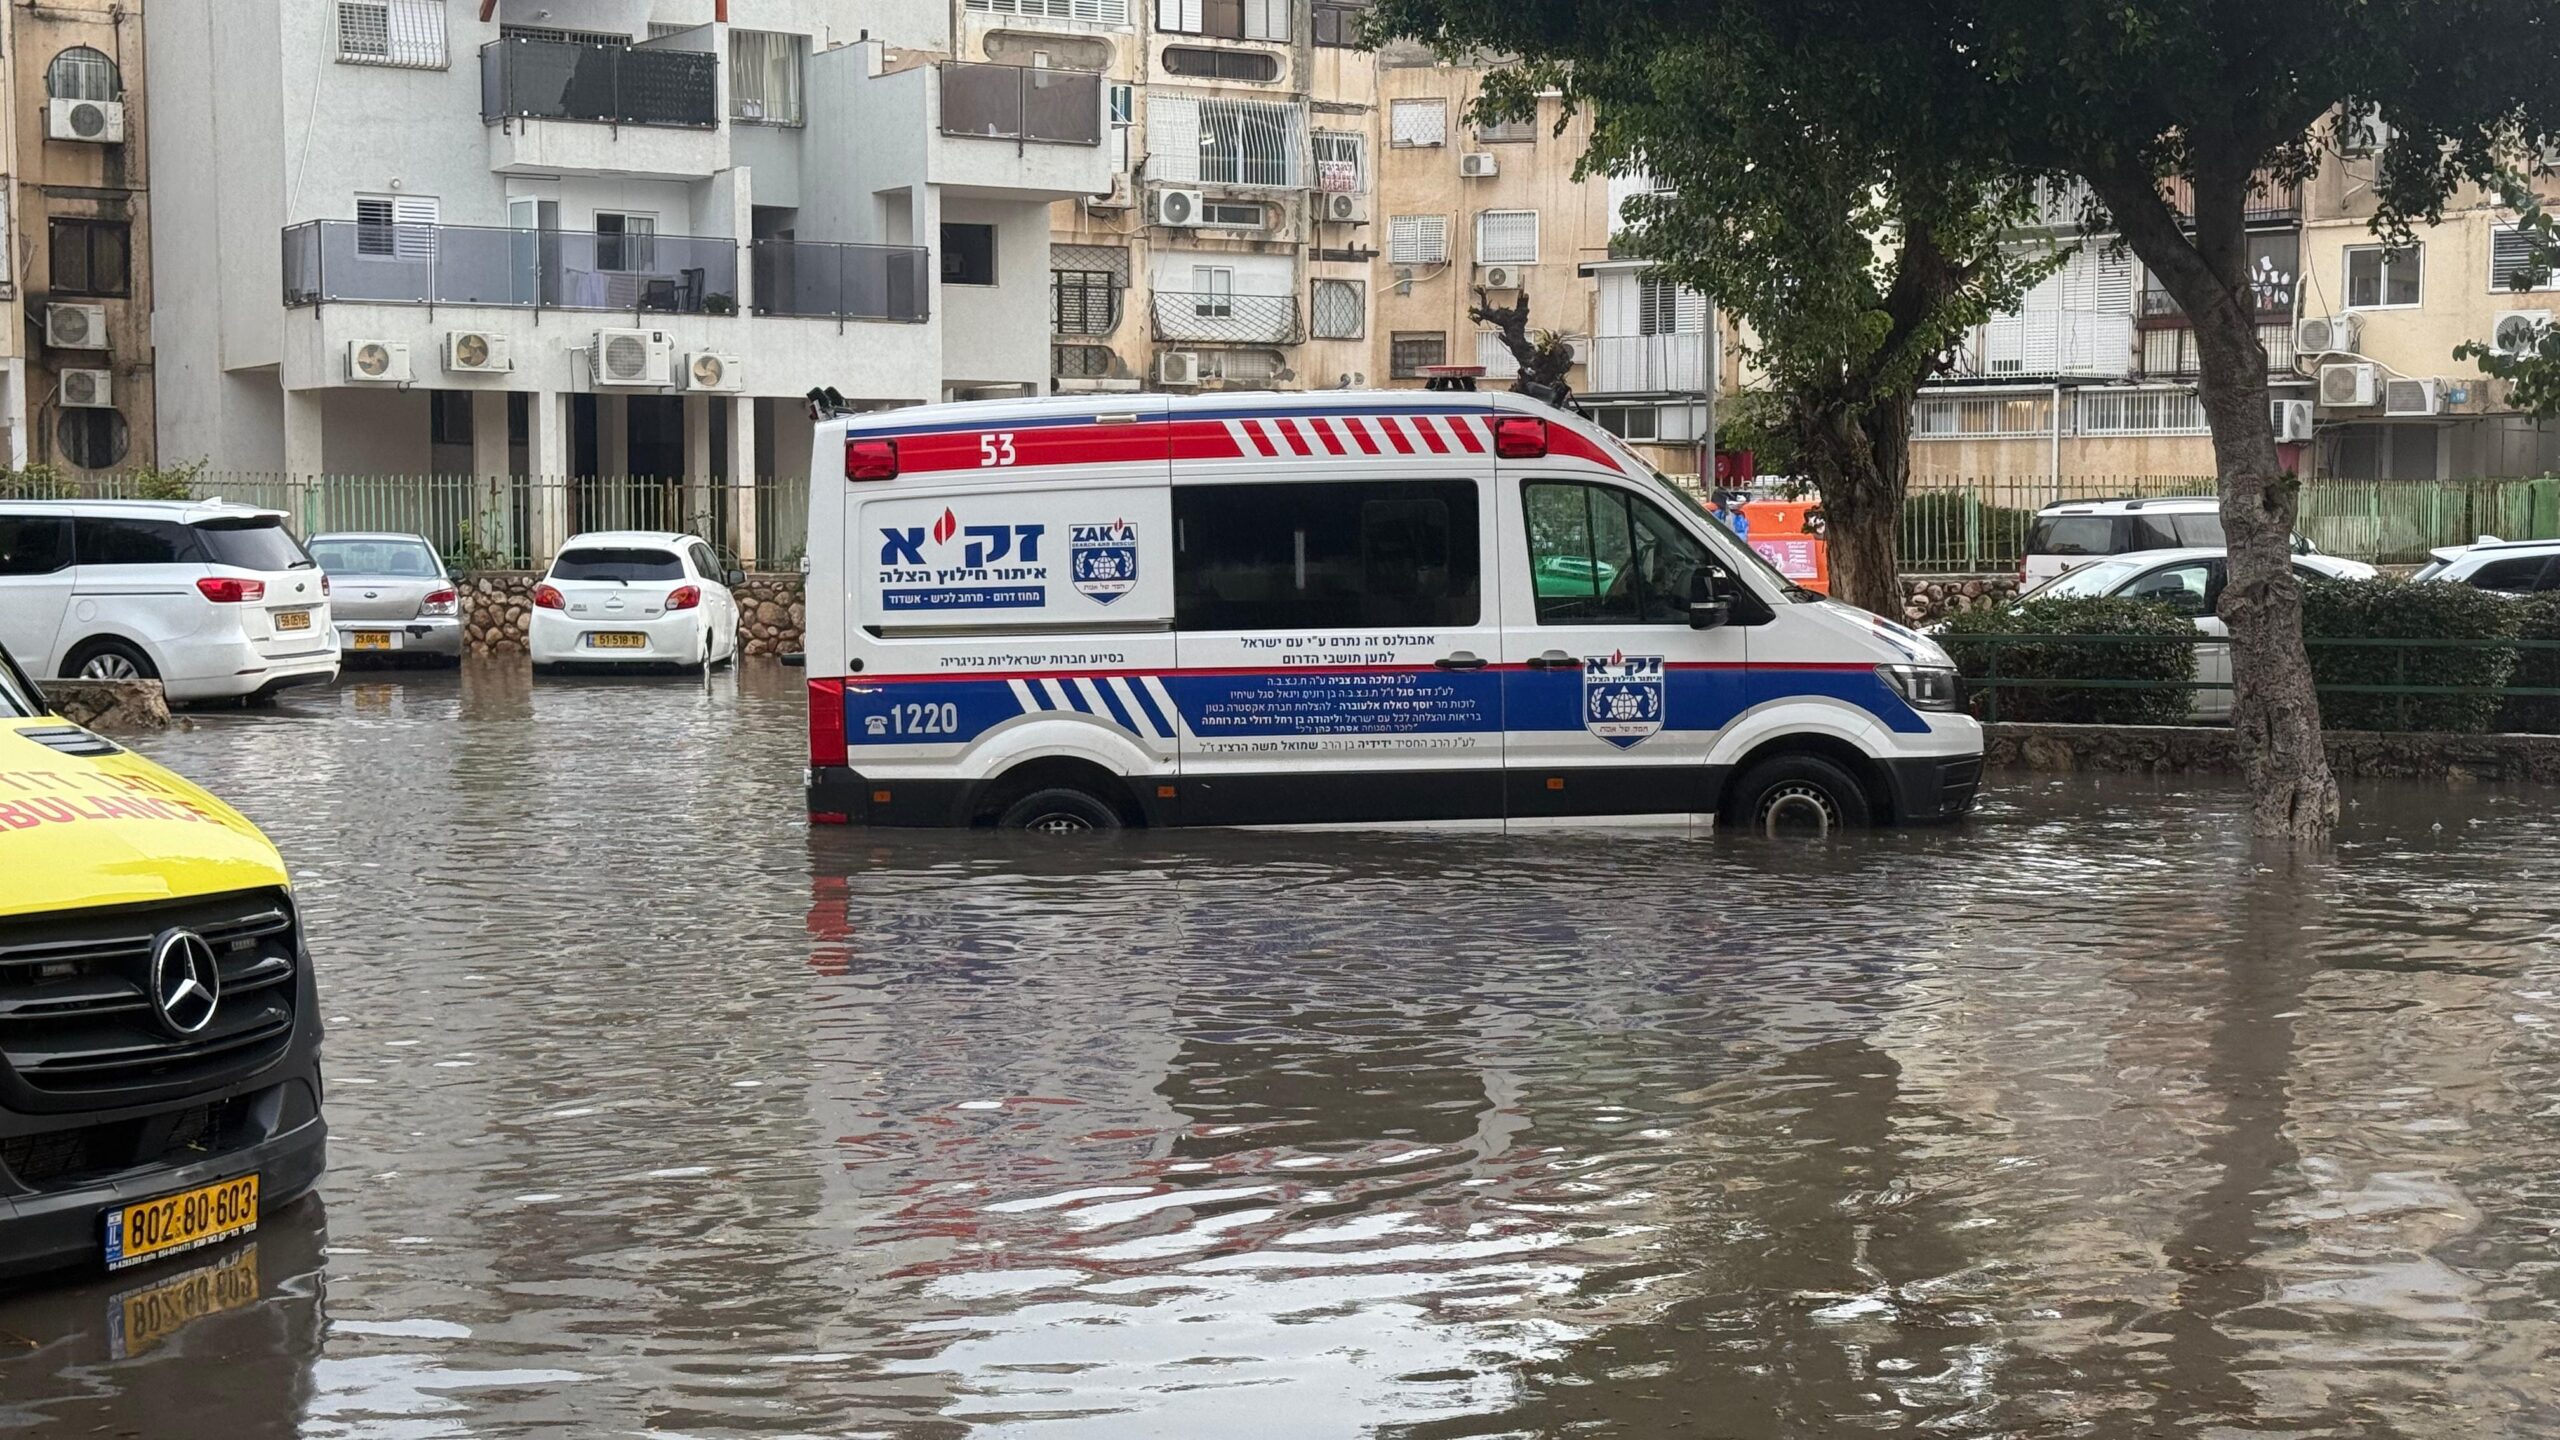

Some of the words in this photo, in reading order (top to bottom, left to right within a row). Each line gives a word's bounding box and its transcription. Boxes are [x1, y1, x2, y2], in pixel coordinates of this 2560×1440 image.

[980, 434, 1016, 467] 53
[879, 568, 931, 582] הצלה
[936, 566, 988, 584] חילוץ
[992, 567, 1046, 579] איתור
[888, 594, 921, 603] אשדוד
[930, 592, 956, 603] לכיש
[957, 593, 984, 602] מרחב
[993, 592, 1015, 601] דרום
[1017, 591, 1040, 600] מחוז
[1240, 637, 1281, 648] ישראל
[1286, 637, 1303, 647] עם
[1306, 635, 1326, 647] ע"י
[1330, 636, 1360, 646] נתרם
[1364, 636, 1378, 646] זה
[1382, 634, 1434, 645] אמבולנס
[940, 656, 985, 666] בניגריה
[987, 654, 1046, 665] ישראליות
[1049, 654, 1086, 664] חברות
[1090, 653, 1124, 663] בסיוע
[1282, 652, 1320, 665] הדרום
[1323, 652, 1361, 665] תושבי
[1365, 649, 1395, 665] למען
[1353, 675, 1368, 685] בת
[1369, 674, 1395, 685] מלכה
[1257, 688, 1274, 699] סגל
[1327, 688, 1337, 698] בן
[1396, 687, 1414, 698] סגל
[1416, 687, 1432, 697] דור
[1226, 703, 1265, 712] אקסטרה
[1267, 703, 1292, 711] חברת
[1294, 701, 1331, 710] להצלחת
[1412, 700, 1433, 710] יוסף
[1435, 700, 1448, 708] מר
[1450, 699, 1475, 708] לזכות
[891, 703, 957, 734] 1220
[1201, 716, 1231, 724] רוחמה
[1233, 716, 1247, 724] בת
[1273, 714, 1293, 724] רחל
[1294, 715, 1304, 725] בן
[1344, 714, 1375, 722] ישראל
[1377, 714, 1390, 722] עם
[1392, 712, 1410, 722] לכל
[1412, 712, 1446, 721] והצלחה
[1314, 725, 1331, 733] כהן
[1251, 741, 1278, 753] משה
[1280, 740, 1319, 752] שמואל
[1321, 740, 1342, 752] הרב
[1344, 739, 1355, 751] בן
[1357, 739, 1392, 751] ידידיה
[1395, 738, 1428, 750] החסיד
[1430, 738, 1450, 750] הרב
